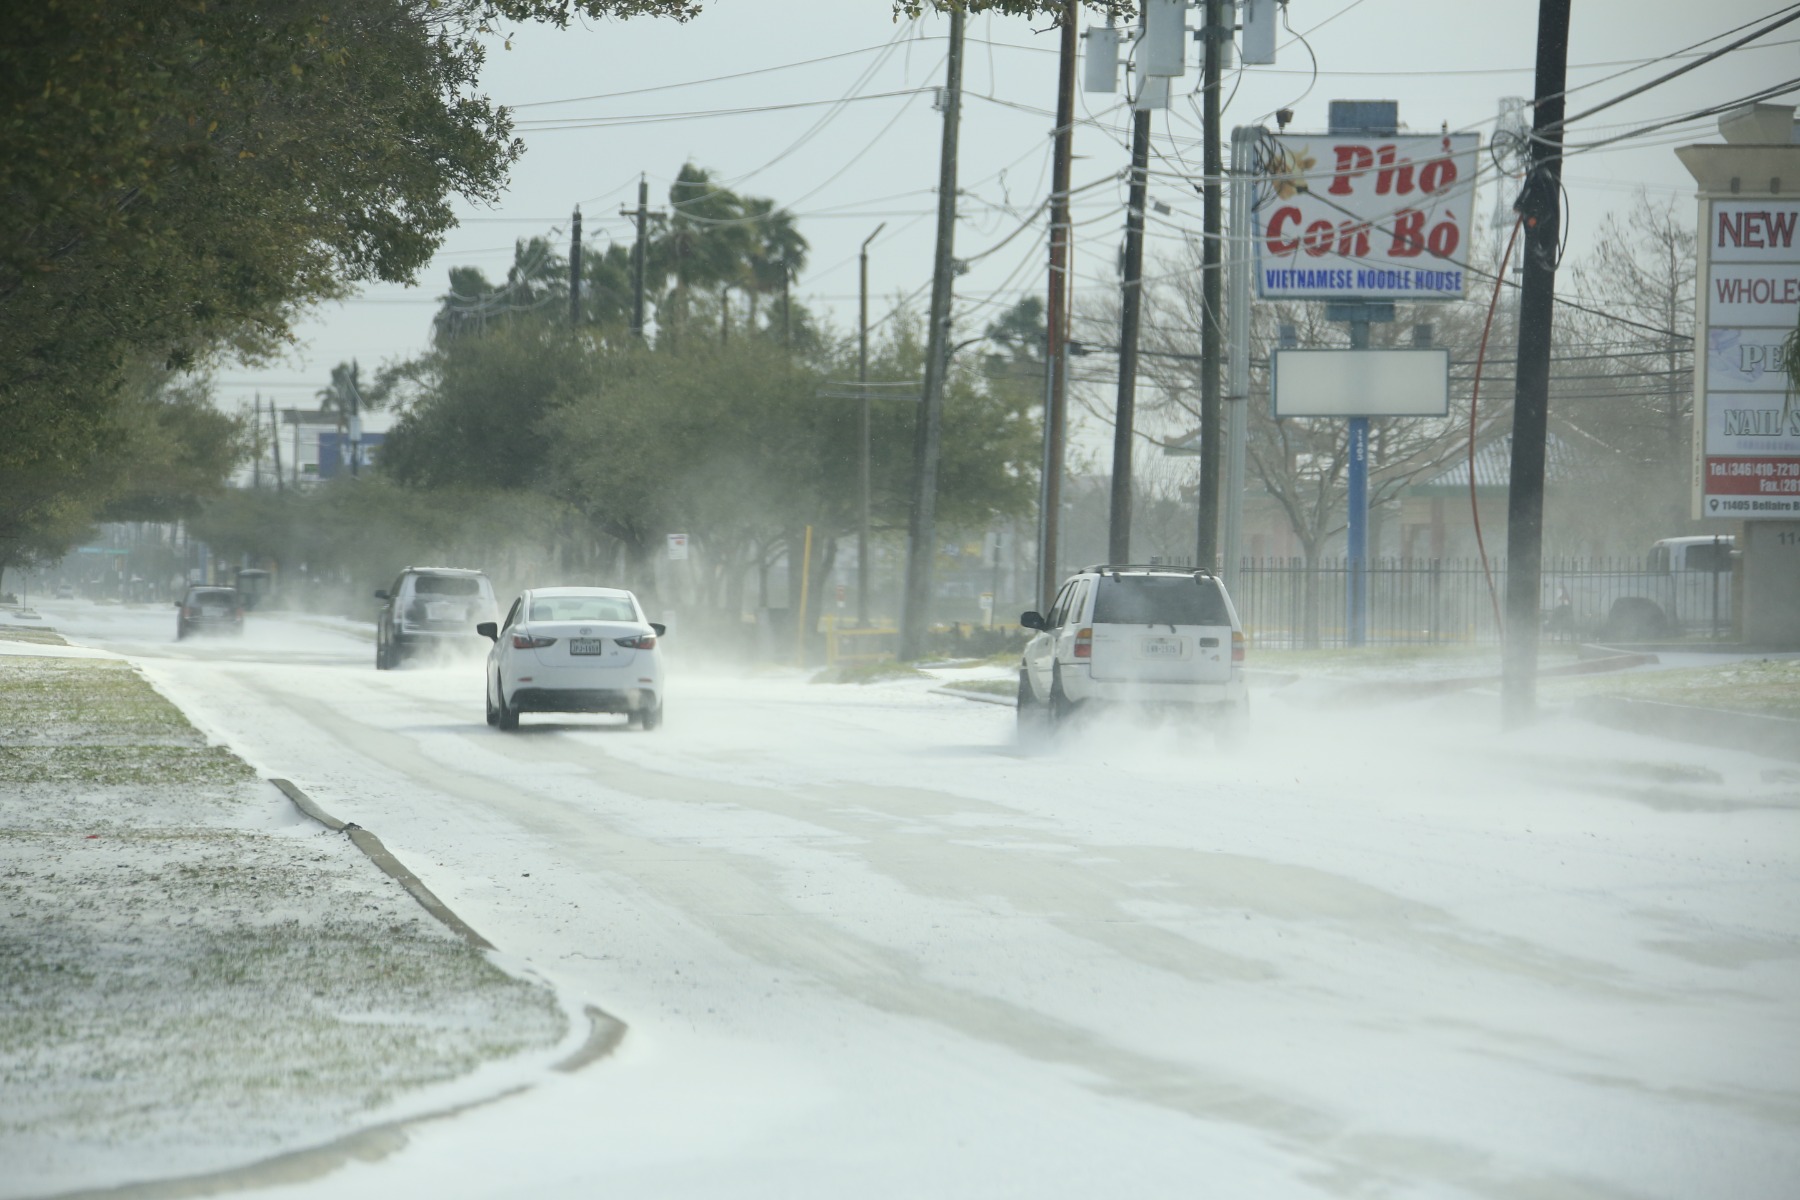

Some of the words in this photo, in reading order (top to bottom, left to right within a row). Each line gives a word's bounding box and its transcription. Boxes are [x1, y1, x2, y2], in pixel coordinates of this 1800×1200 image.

[1265, 206, 1372, 258] Con
[1387, 208, 1460, 259] Bò
[1718, 211, 1799, 249] NEW
[1266, 269, 1353, 289] VIETNAMESE
[1357, 270, 1411, 290] NOODLE
[1415, 271, 1462, 291] HOUSE
[1723, 409, 1783, 436] NAIL
[1722, 501, 1750, 511] 11405
[1752, 501, 1792, 511] Bellaire
